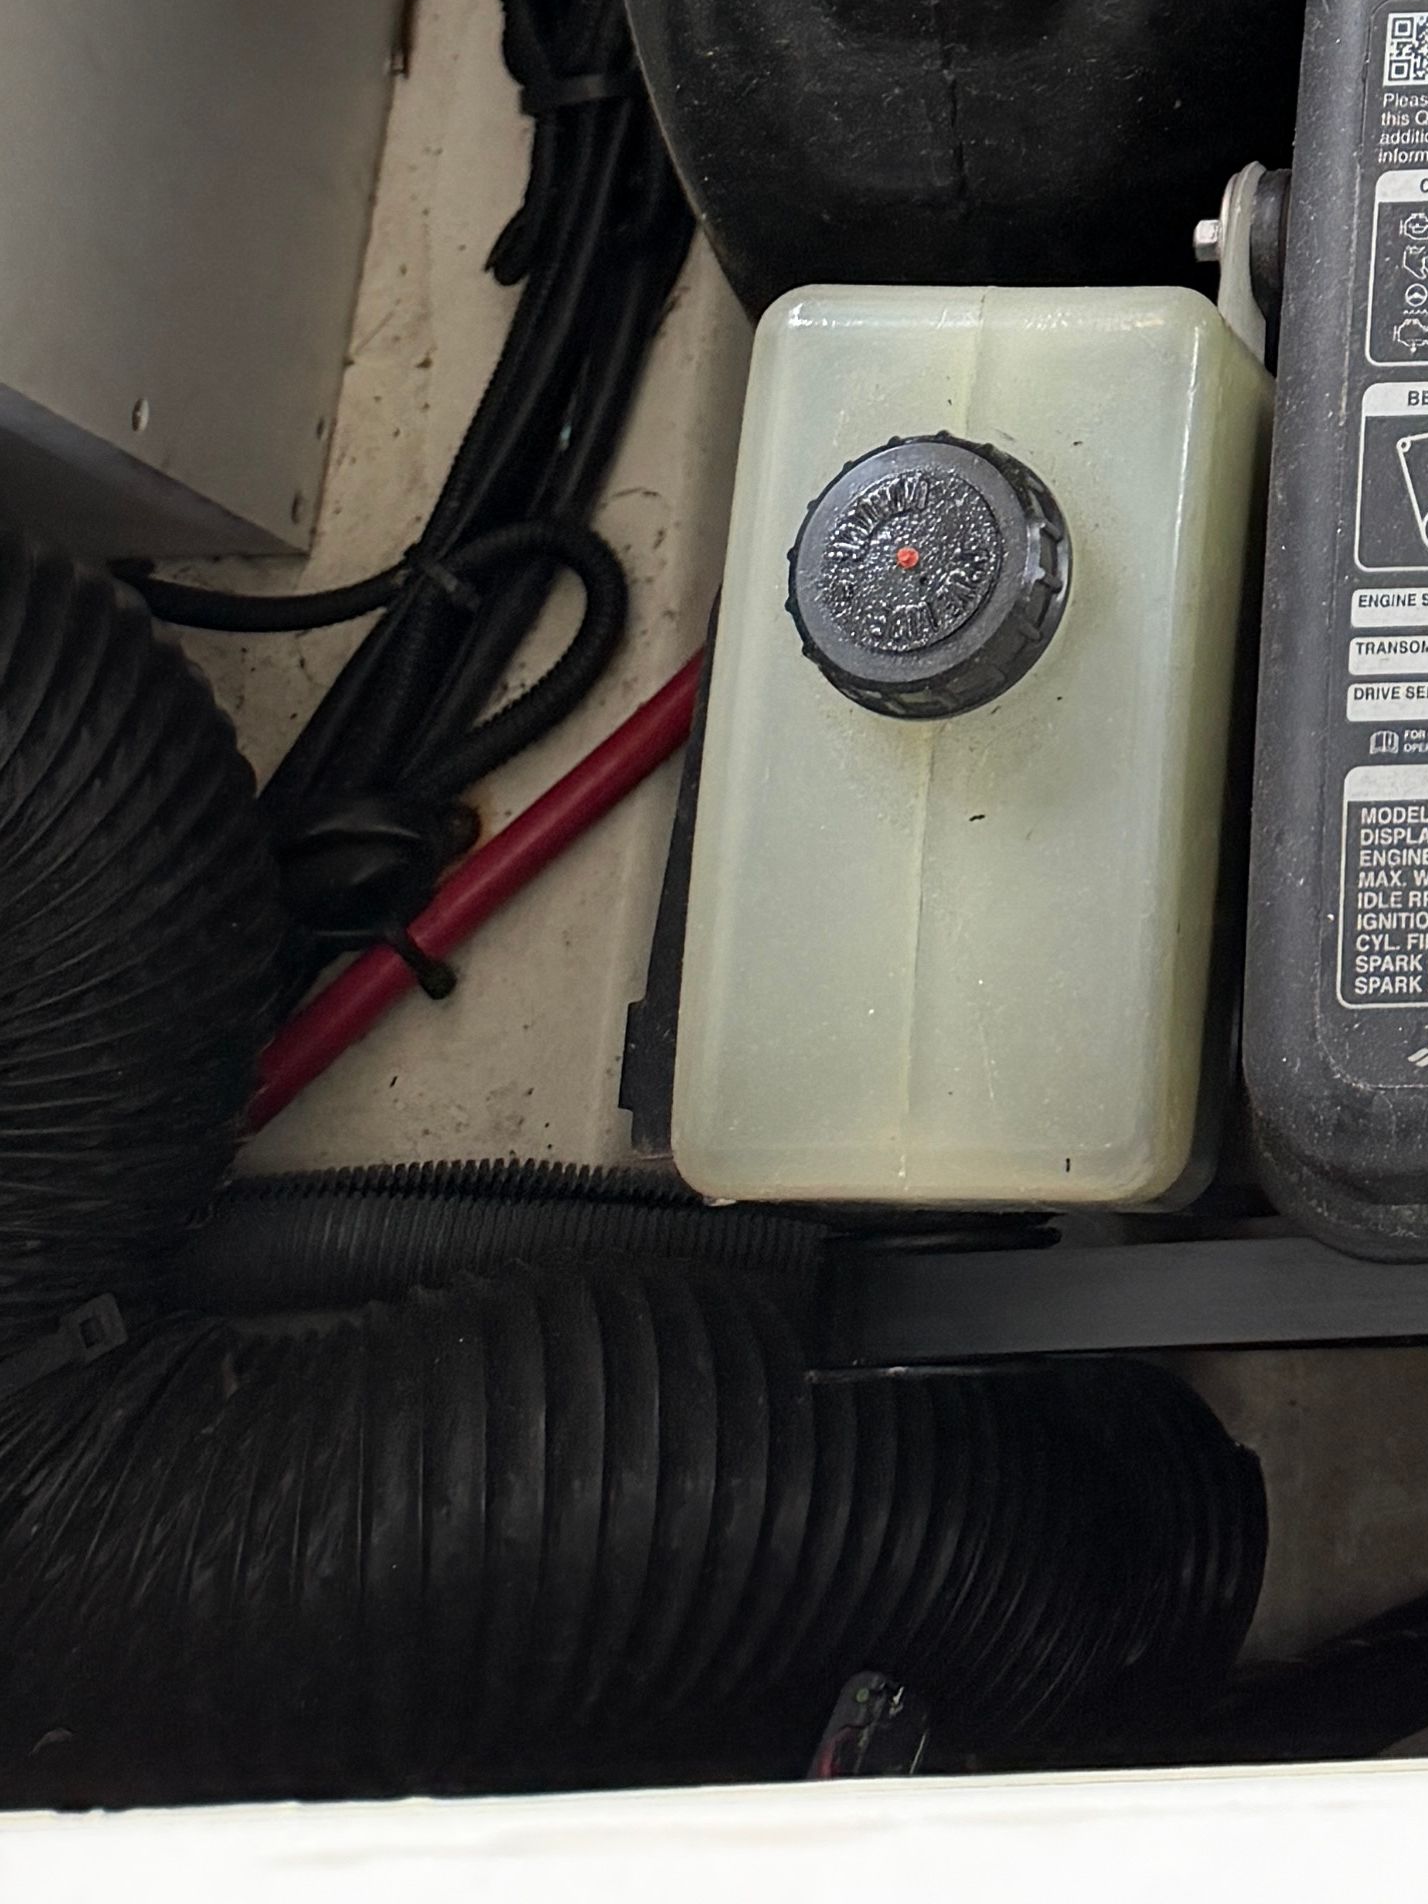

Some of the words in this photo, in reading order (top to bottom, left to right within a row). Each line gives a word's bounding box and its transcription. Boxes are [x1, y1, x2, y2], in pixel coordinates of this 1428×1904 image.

[1381, 110, 1410, 126] this
[1358, 593, 1417, 609] ENGINE
[1353, 685, 1402, 702] DRIVE
[1403, 729, 1426, 740] FOR
[1358, 870, 1407, 888] MAX.
[1358, 891, 1402, 909] IDLE
[1356, 934, 1400, 952] CYL.
[1355, 955, 1423, 973] SPARK
[1354, 976, 1423, 995] SPARK
